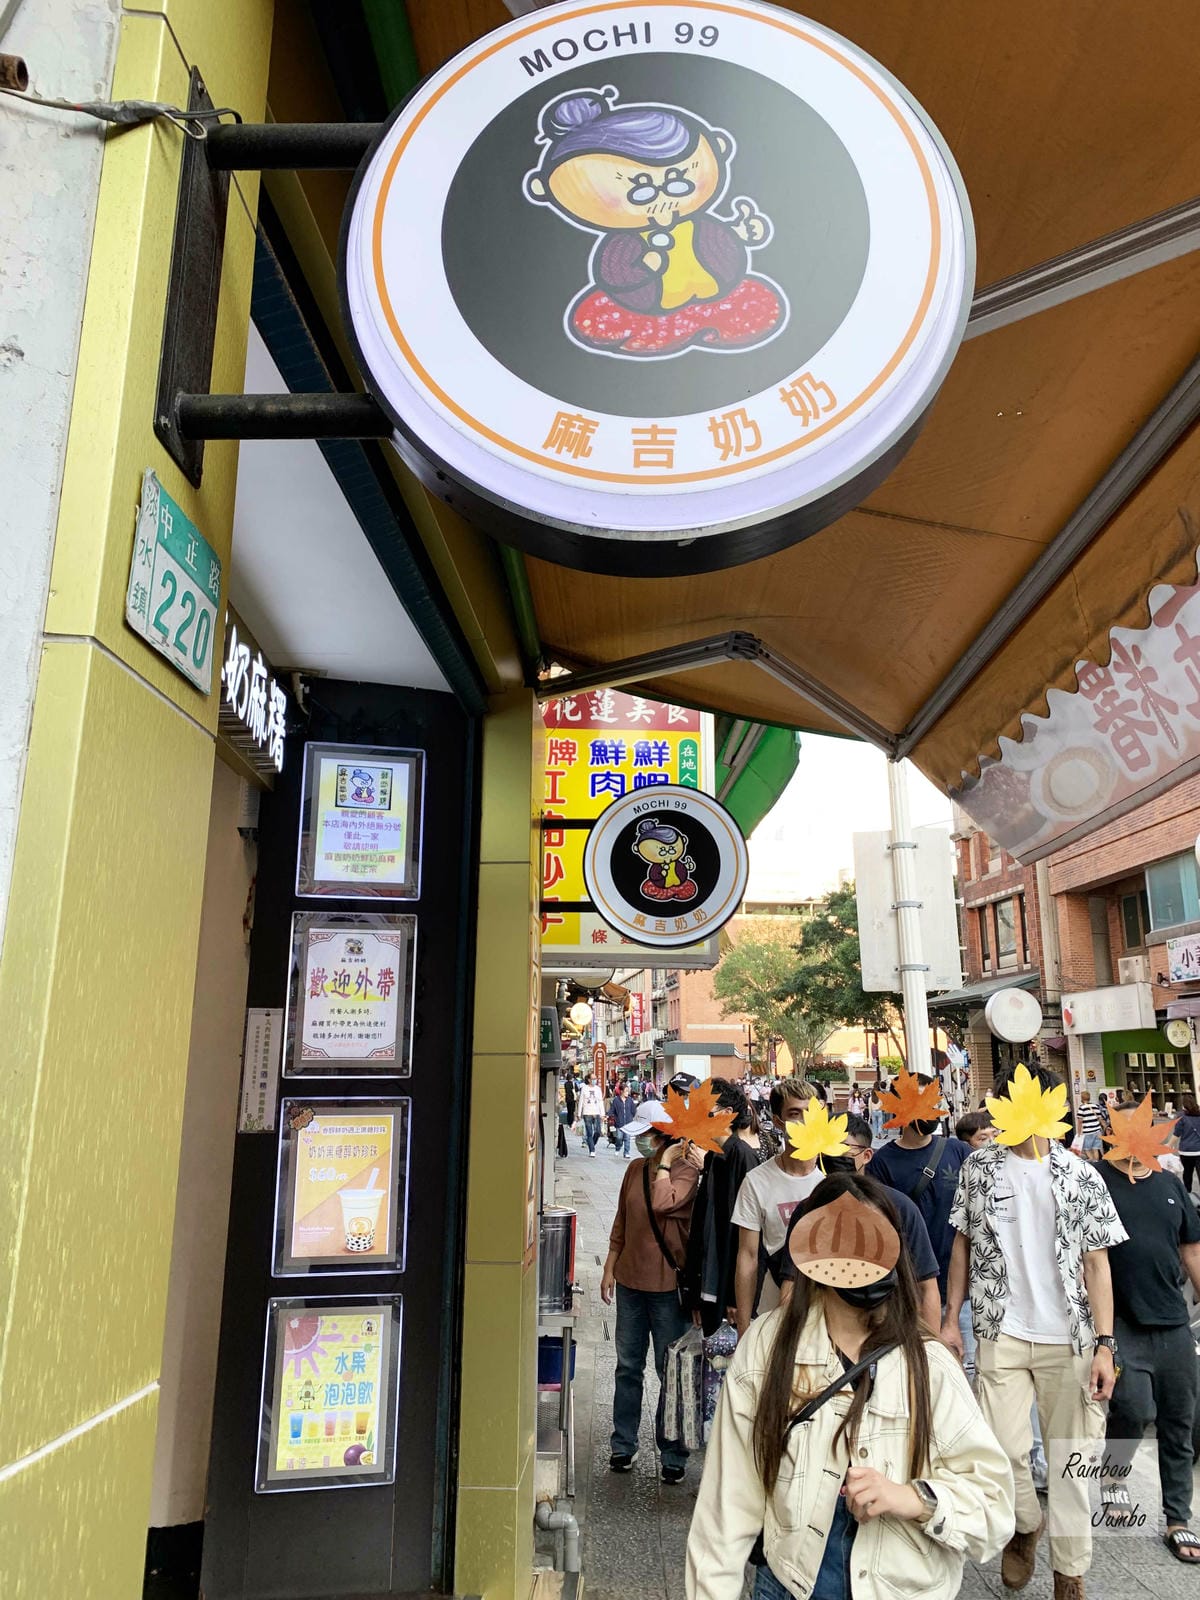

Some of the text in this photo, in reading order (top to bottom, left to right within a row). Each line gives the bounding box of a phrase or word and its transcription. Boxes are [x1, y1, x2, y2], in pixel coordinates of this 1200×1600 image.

[518, 21, 721, 77] MOCHI 99
[542, 371, 838, 470] 麻吉奶奶
[160, 503, 221, 598] 中正路
[152, 569, 211, 670] 220
[221, 610, 287, 773] 奶麻糬
[552, 688, 689, 725] 花蓮美食
[633, 800, 688, 815] MOCHI 99
[632, 908, 708, 932] 麻吉奶奶
[309, 967, 396, 1001] 歡迎外帶
[334, 1351, 367, 1375] 水果
[323, 1382, 374, 1407] 泡泡飲
